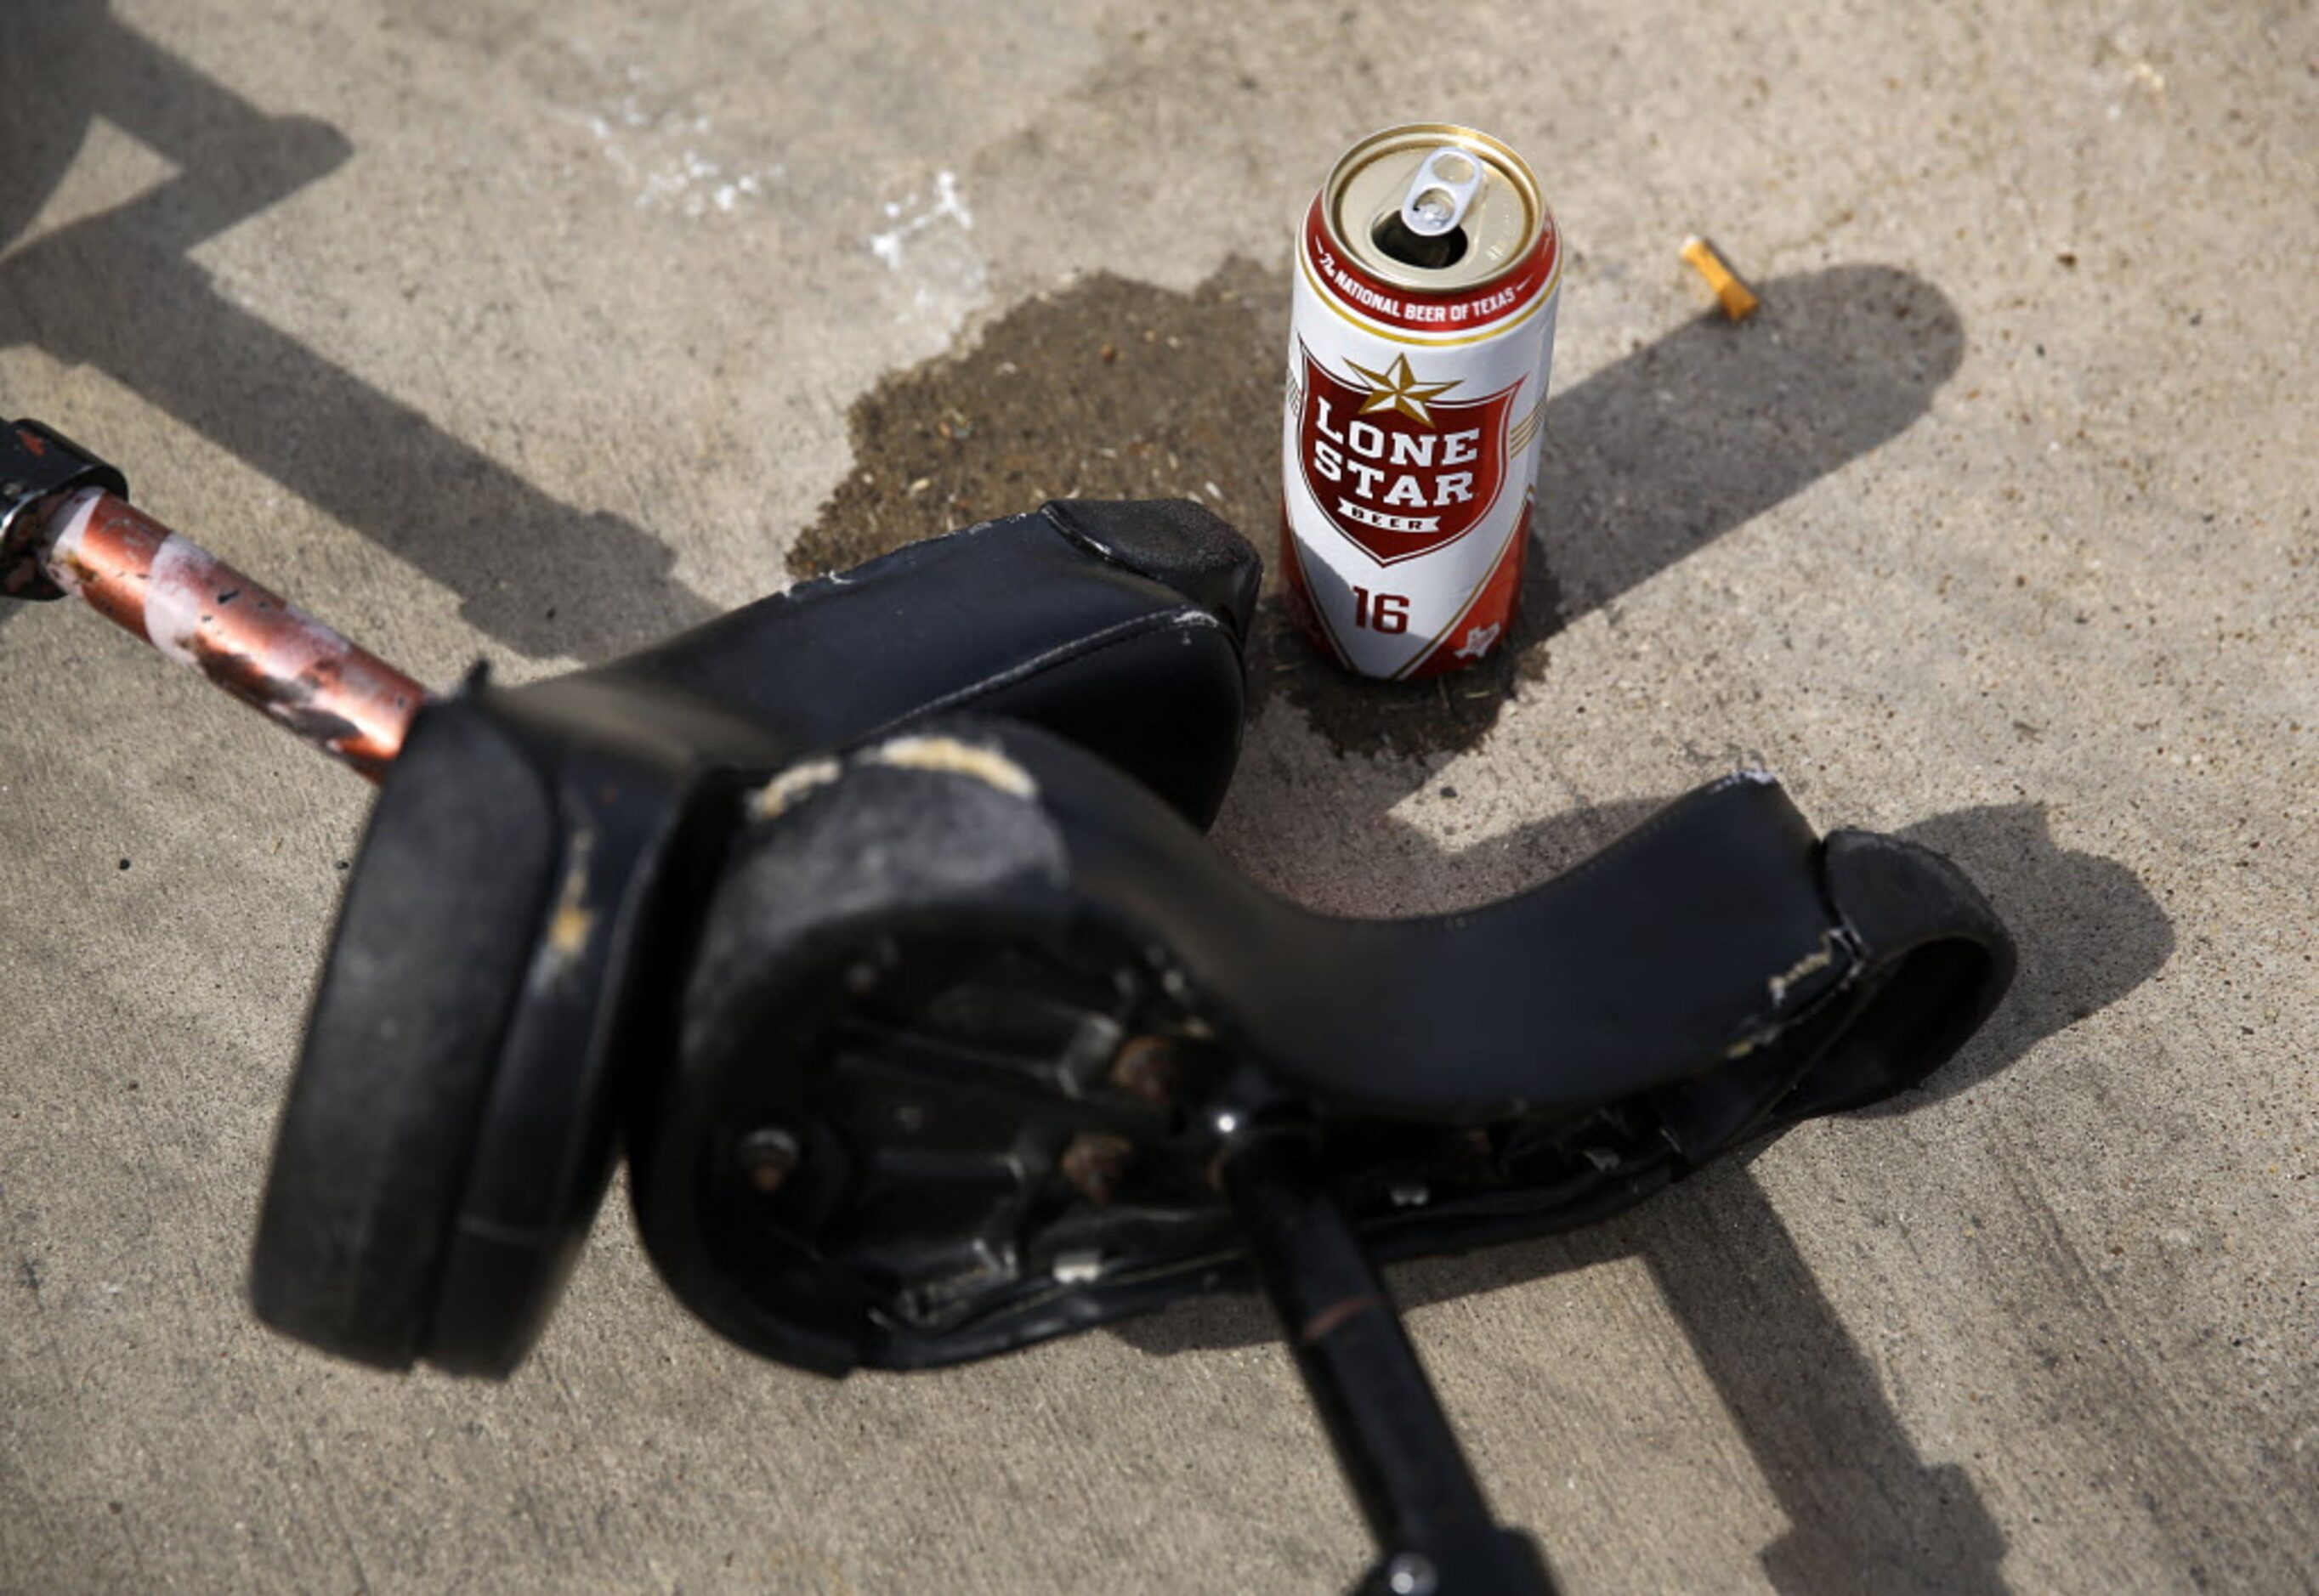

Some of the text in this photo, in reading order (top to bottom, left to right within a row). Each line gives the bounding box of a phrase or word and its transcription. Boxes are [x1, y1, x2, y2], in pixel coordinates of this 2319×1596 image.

[1319, 253, 1516, 322] The NATIONAL BEER OF TEXAS
[1317, 395, 1480, 467] LONE
[1313, 439, 1473, 507] STAR
[1352, 507, 1422, 530] BEER
[1352, 585, 1409, 635] 16
